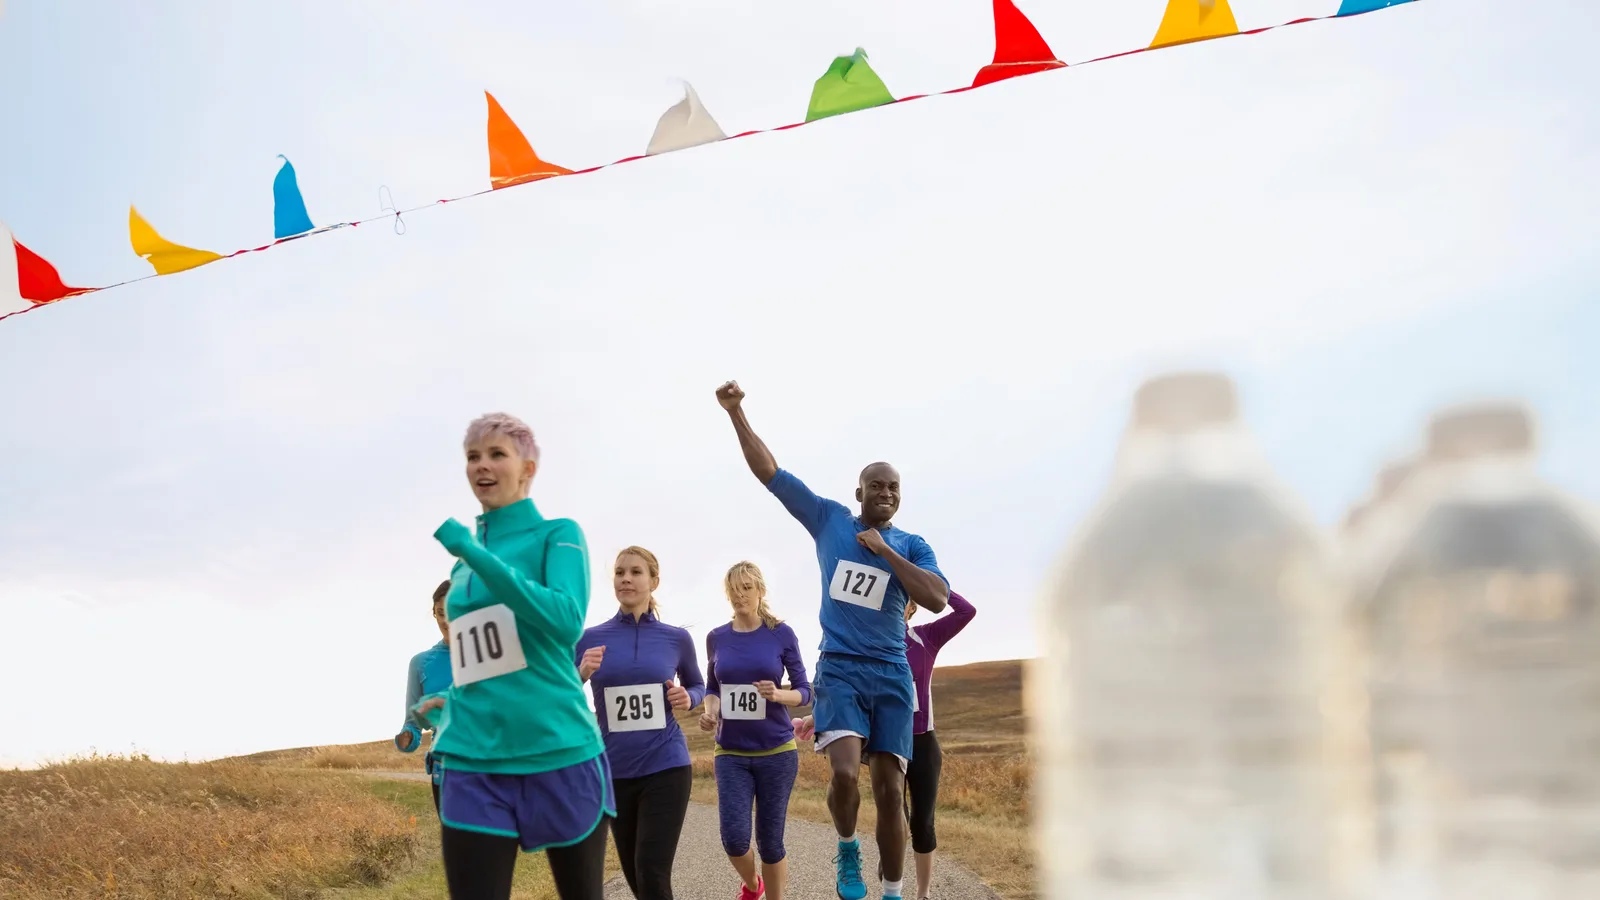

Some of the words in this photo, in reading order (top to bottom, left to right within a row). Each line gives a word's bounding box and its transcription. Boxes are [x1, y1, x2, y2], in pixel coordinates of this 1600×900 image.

[842, 569, 878, 598] 127
[457, 621, 504, 668] 110
[615, 693, 654, 721] 295
[729, 691, 758, 712] 148
